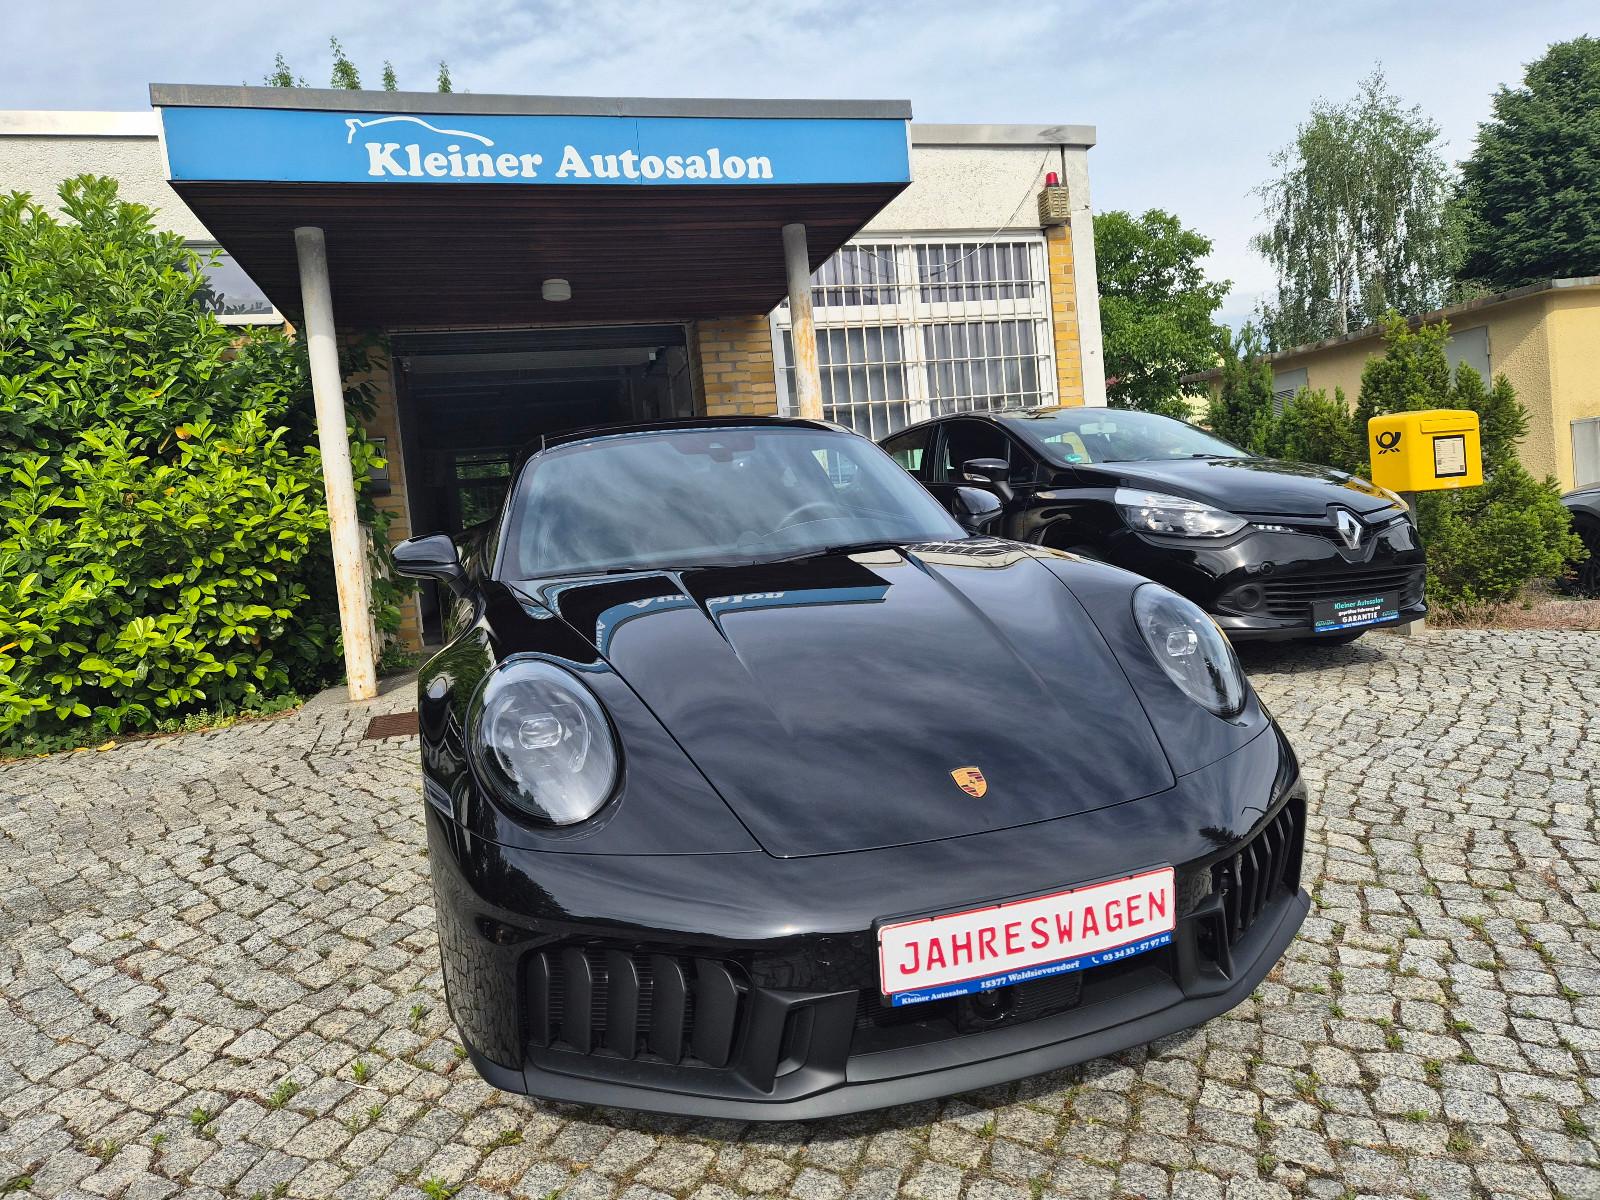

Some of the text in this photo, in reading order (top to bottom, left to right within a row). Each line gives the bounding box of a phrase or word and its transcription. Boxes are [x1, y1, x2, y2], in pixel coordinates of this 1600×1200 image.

[364, 142, 773, 180] Kleiner Autosalon
[1334, 597, 1384, 610] Kleiner Autosalon
[1342, 611, 1378, 623] GARANTIE
[900, 888, 1166, 975] JAHRESWAGEN
[1114, 950, 1125, 959] 34
[1125, 946, 1136, 956] 33
[1139, 942, 1150, 951] 57
[1150, 938, 1160, 948] 97
[1160, 935, 1170, 943] 01
[980, 960, 1081, 989] 15377 Waldsieversdorf
[901, 988, 968, 1005] Kleiner Autosalon
